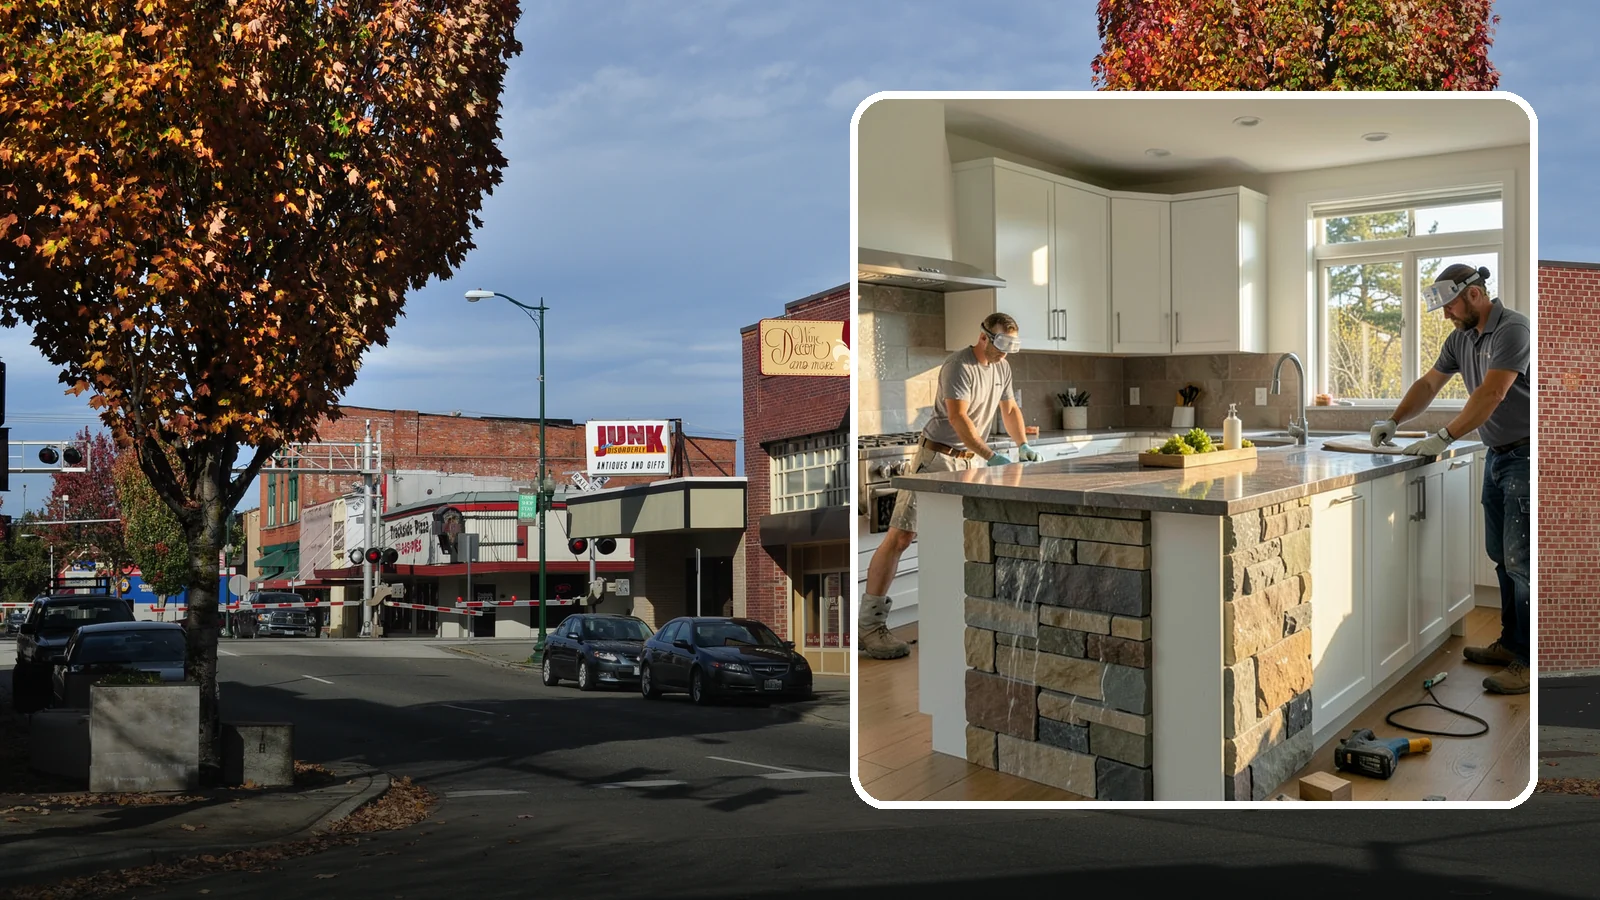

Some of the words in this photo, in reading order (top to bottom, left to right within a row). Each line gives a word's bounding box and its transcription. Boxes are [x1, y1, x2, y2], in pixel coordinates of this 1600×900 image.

[595, 425, 665, 457] JUNK
[607, 446, 646, 454] DISORDERLY
[597, 461, 628, 470] ANTIQUES
[631, 461, 644, 470] AND
[646, 460, 665, 469] GIFTS
[390, 521, 413, 539] Trackside
[414, 519, 429, 535] Pizza
